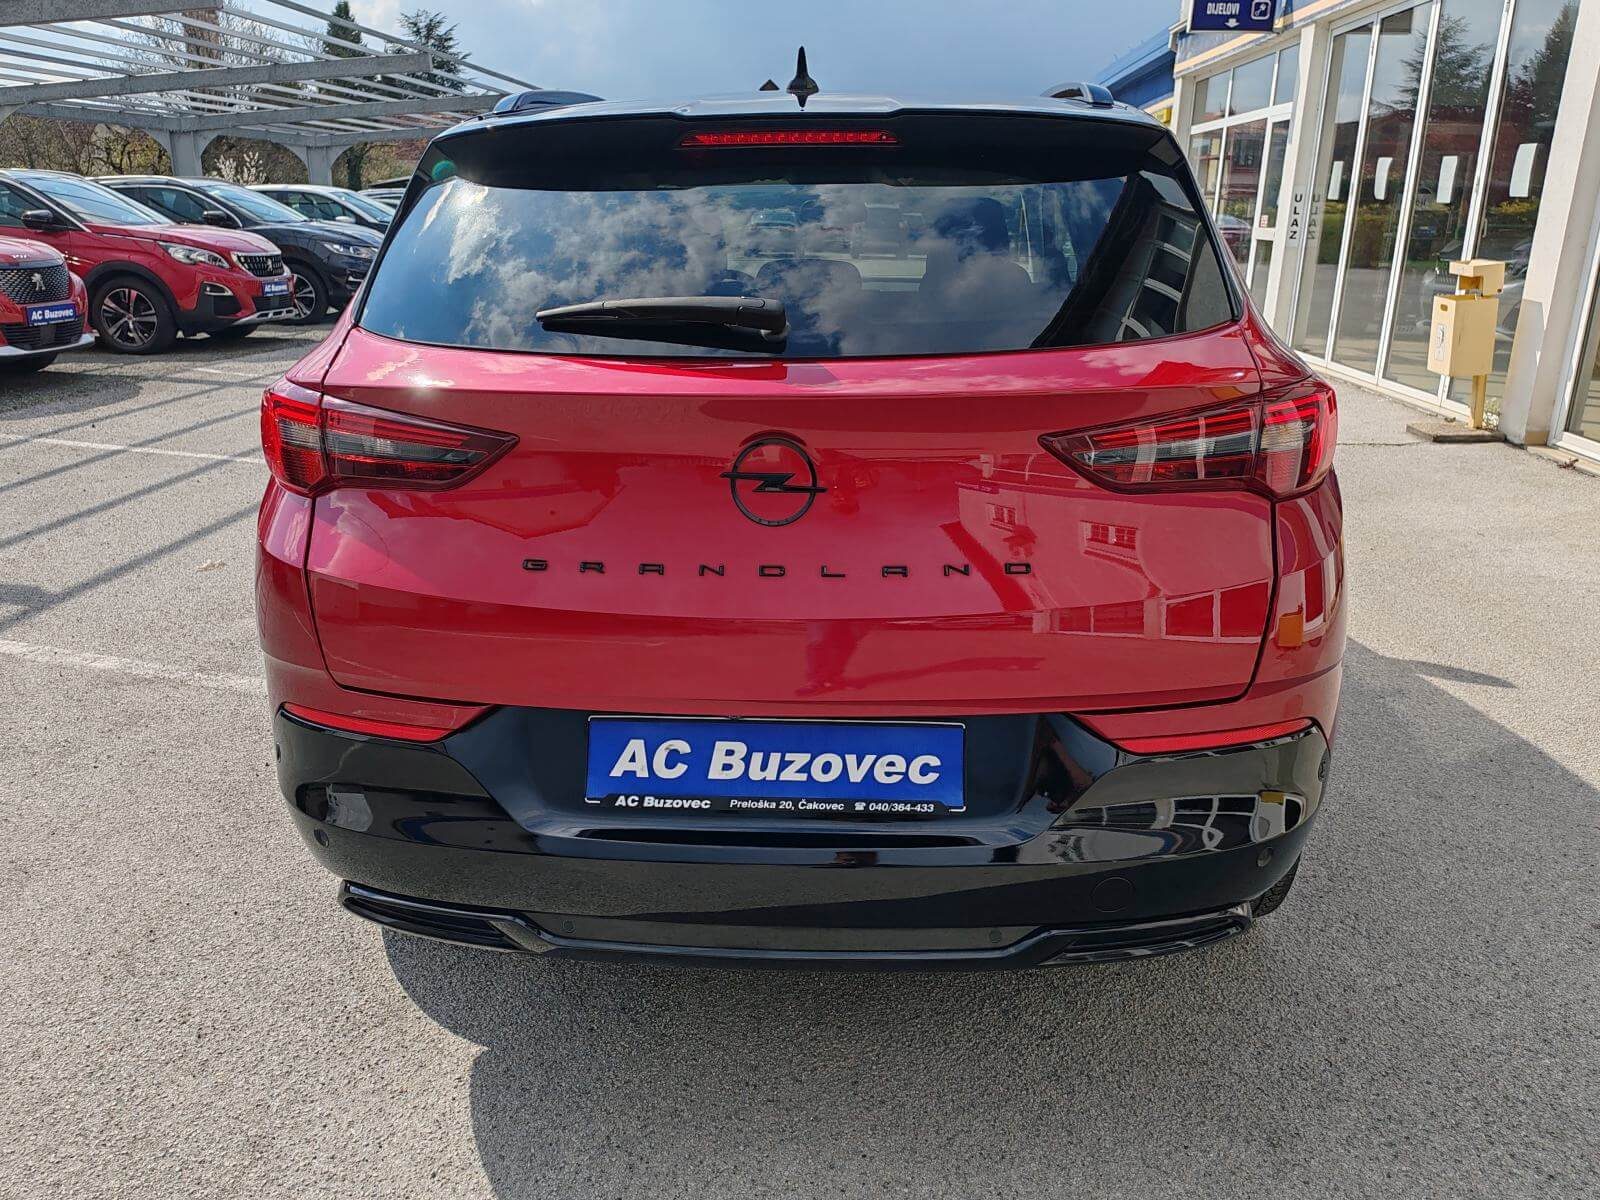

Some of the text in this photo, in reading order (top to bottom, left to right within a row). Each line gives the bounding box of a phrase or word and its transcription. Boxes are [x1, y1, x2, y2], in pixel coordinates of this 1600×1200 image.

[1207, 2, 1240, 15] DIJELOVI
[1289, 193, 1303, 240] ULAZ
[31, 309, 74, 321] AC Buzovec
[522, 557, 1033, 578] GRANDLAND
[609, 738, 941, 785] AC Buzovec
[614, 795, 934, 812] AC Buzovec Preloška 20, Čakovec 040/364-433
